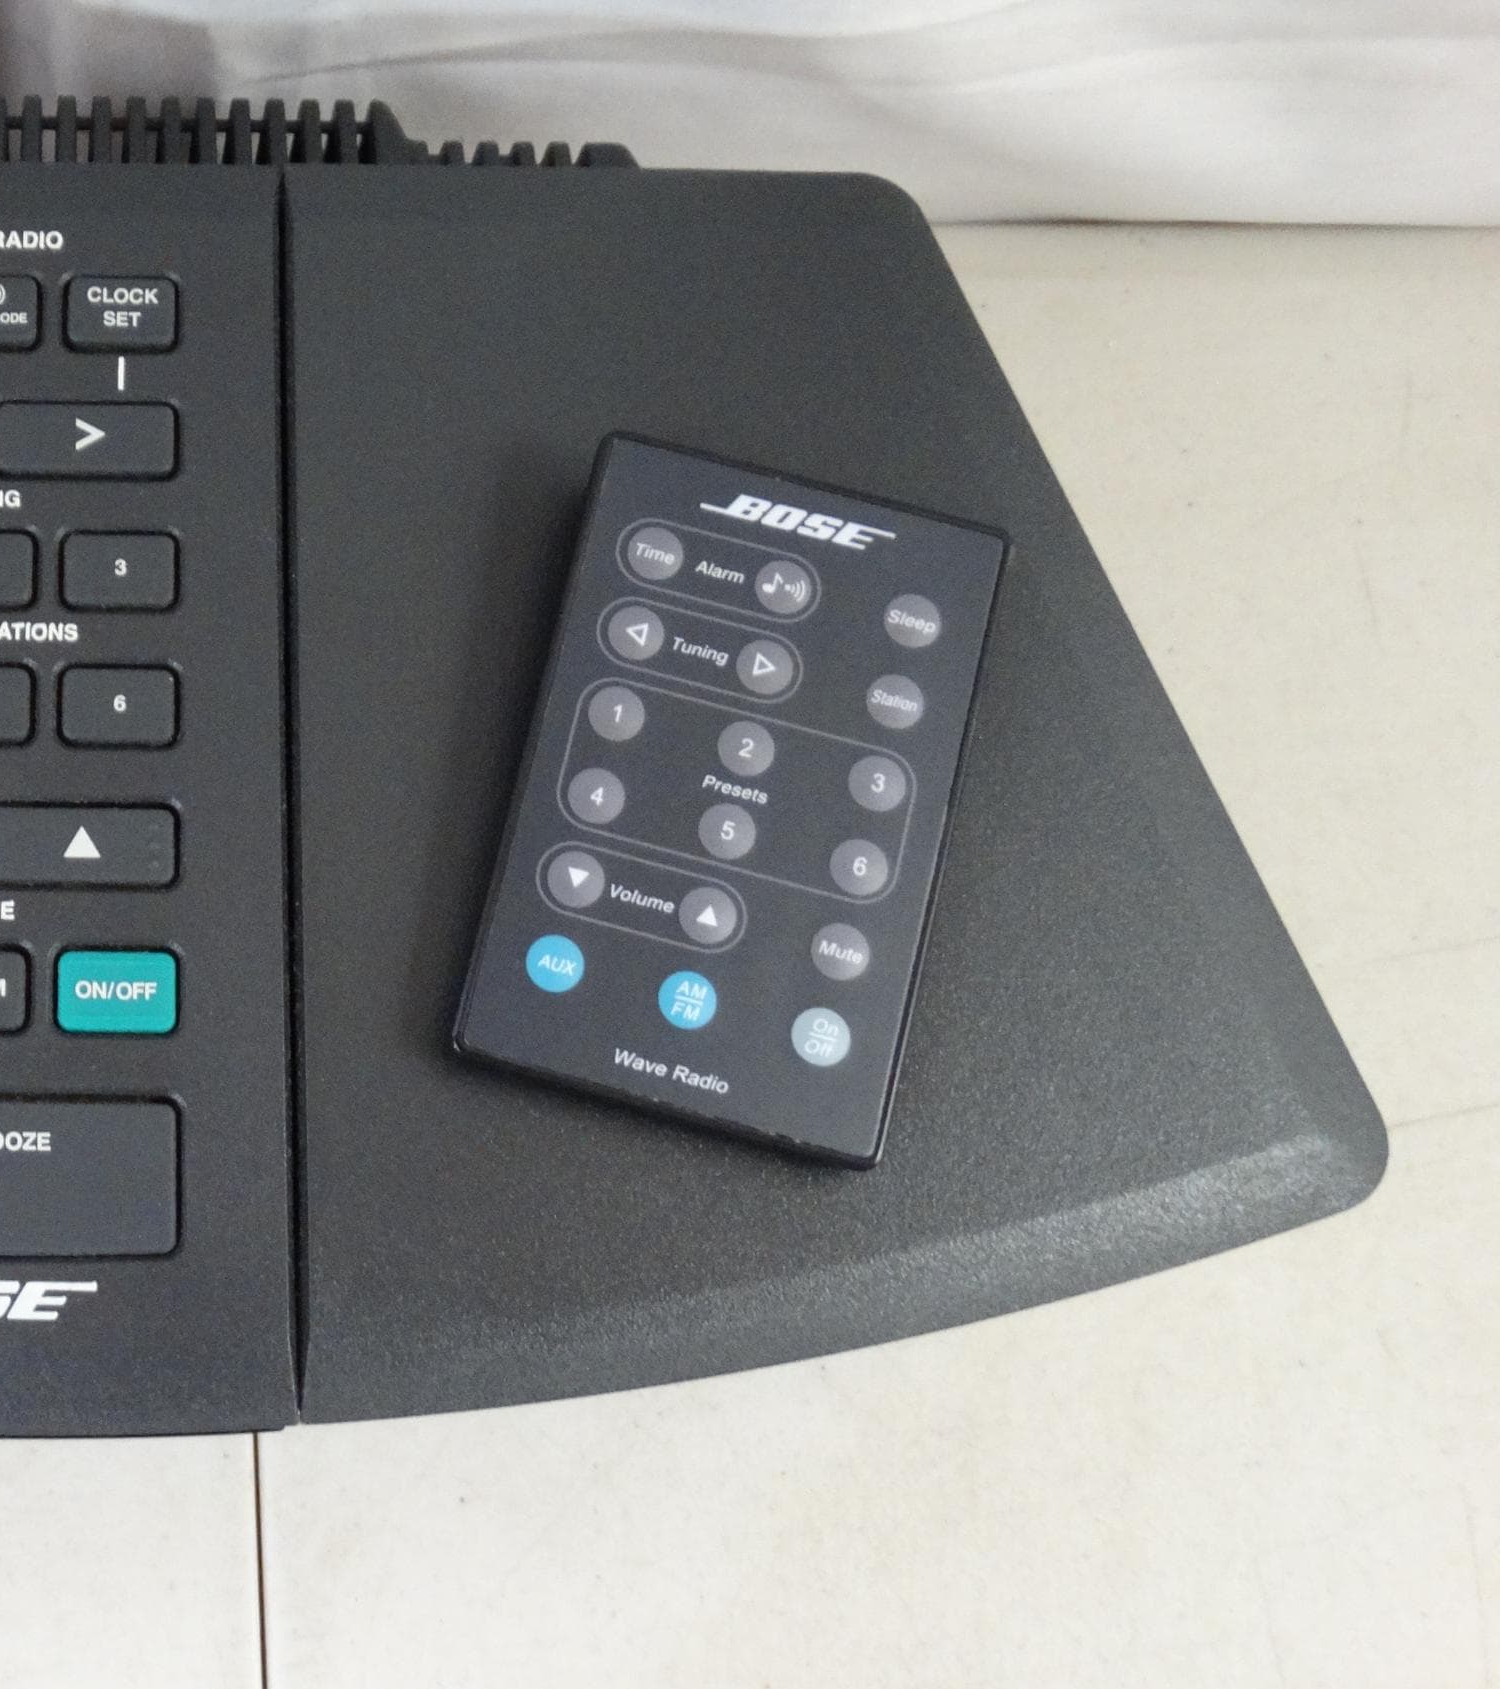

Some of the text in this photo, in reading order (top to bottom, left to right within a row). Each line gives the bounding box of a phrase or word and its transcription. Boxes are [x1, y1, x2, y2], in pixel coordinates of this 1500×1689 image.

[87, 287, 158, 304] CLOCK
[104, 311, 140, 327] SET
[700, 494, 896, 550] BOSE
[635, 541, 675, 566] Time
[115, 559, 127, 575] 3
[695, 561, 745, 585] Alarm
[888, 609, 936, 636] Sleep
[672, 637, 729, 667] Tuning
[114, 695, 126, 711] 6
[871, 689, 918, 714] Station
[613, 705, 623, 722] 1
[739, 739, 754, 758] 2
[702, 774, 768, 805] Presets
[871, 773, 885, 793] 3
[591, 788, 604, 805] 4
[721, 822, 735, 840] 5
[853, 857, 867, 876] 6
[610, 883, 675, 914] Volume
[819, 939, 863, 965] Mute
[537, 954, 577, 977] AUX
[75, 981, 157, 1000] ON/OFF
[676, 980, 707, 999] AM
[671, 1003, 700, 1022] FM
[813, 1018, 839, 1038] On
[804, 1038, 835, 1057] Off
[614, 1048, 729, 1095] Wave Radio
